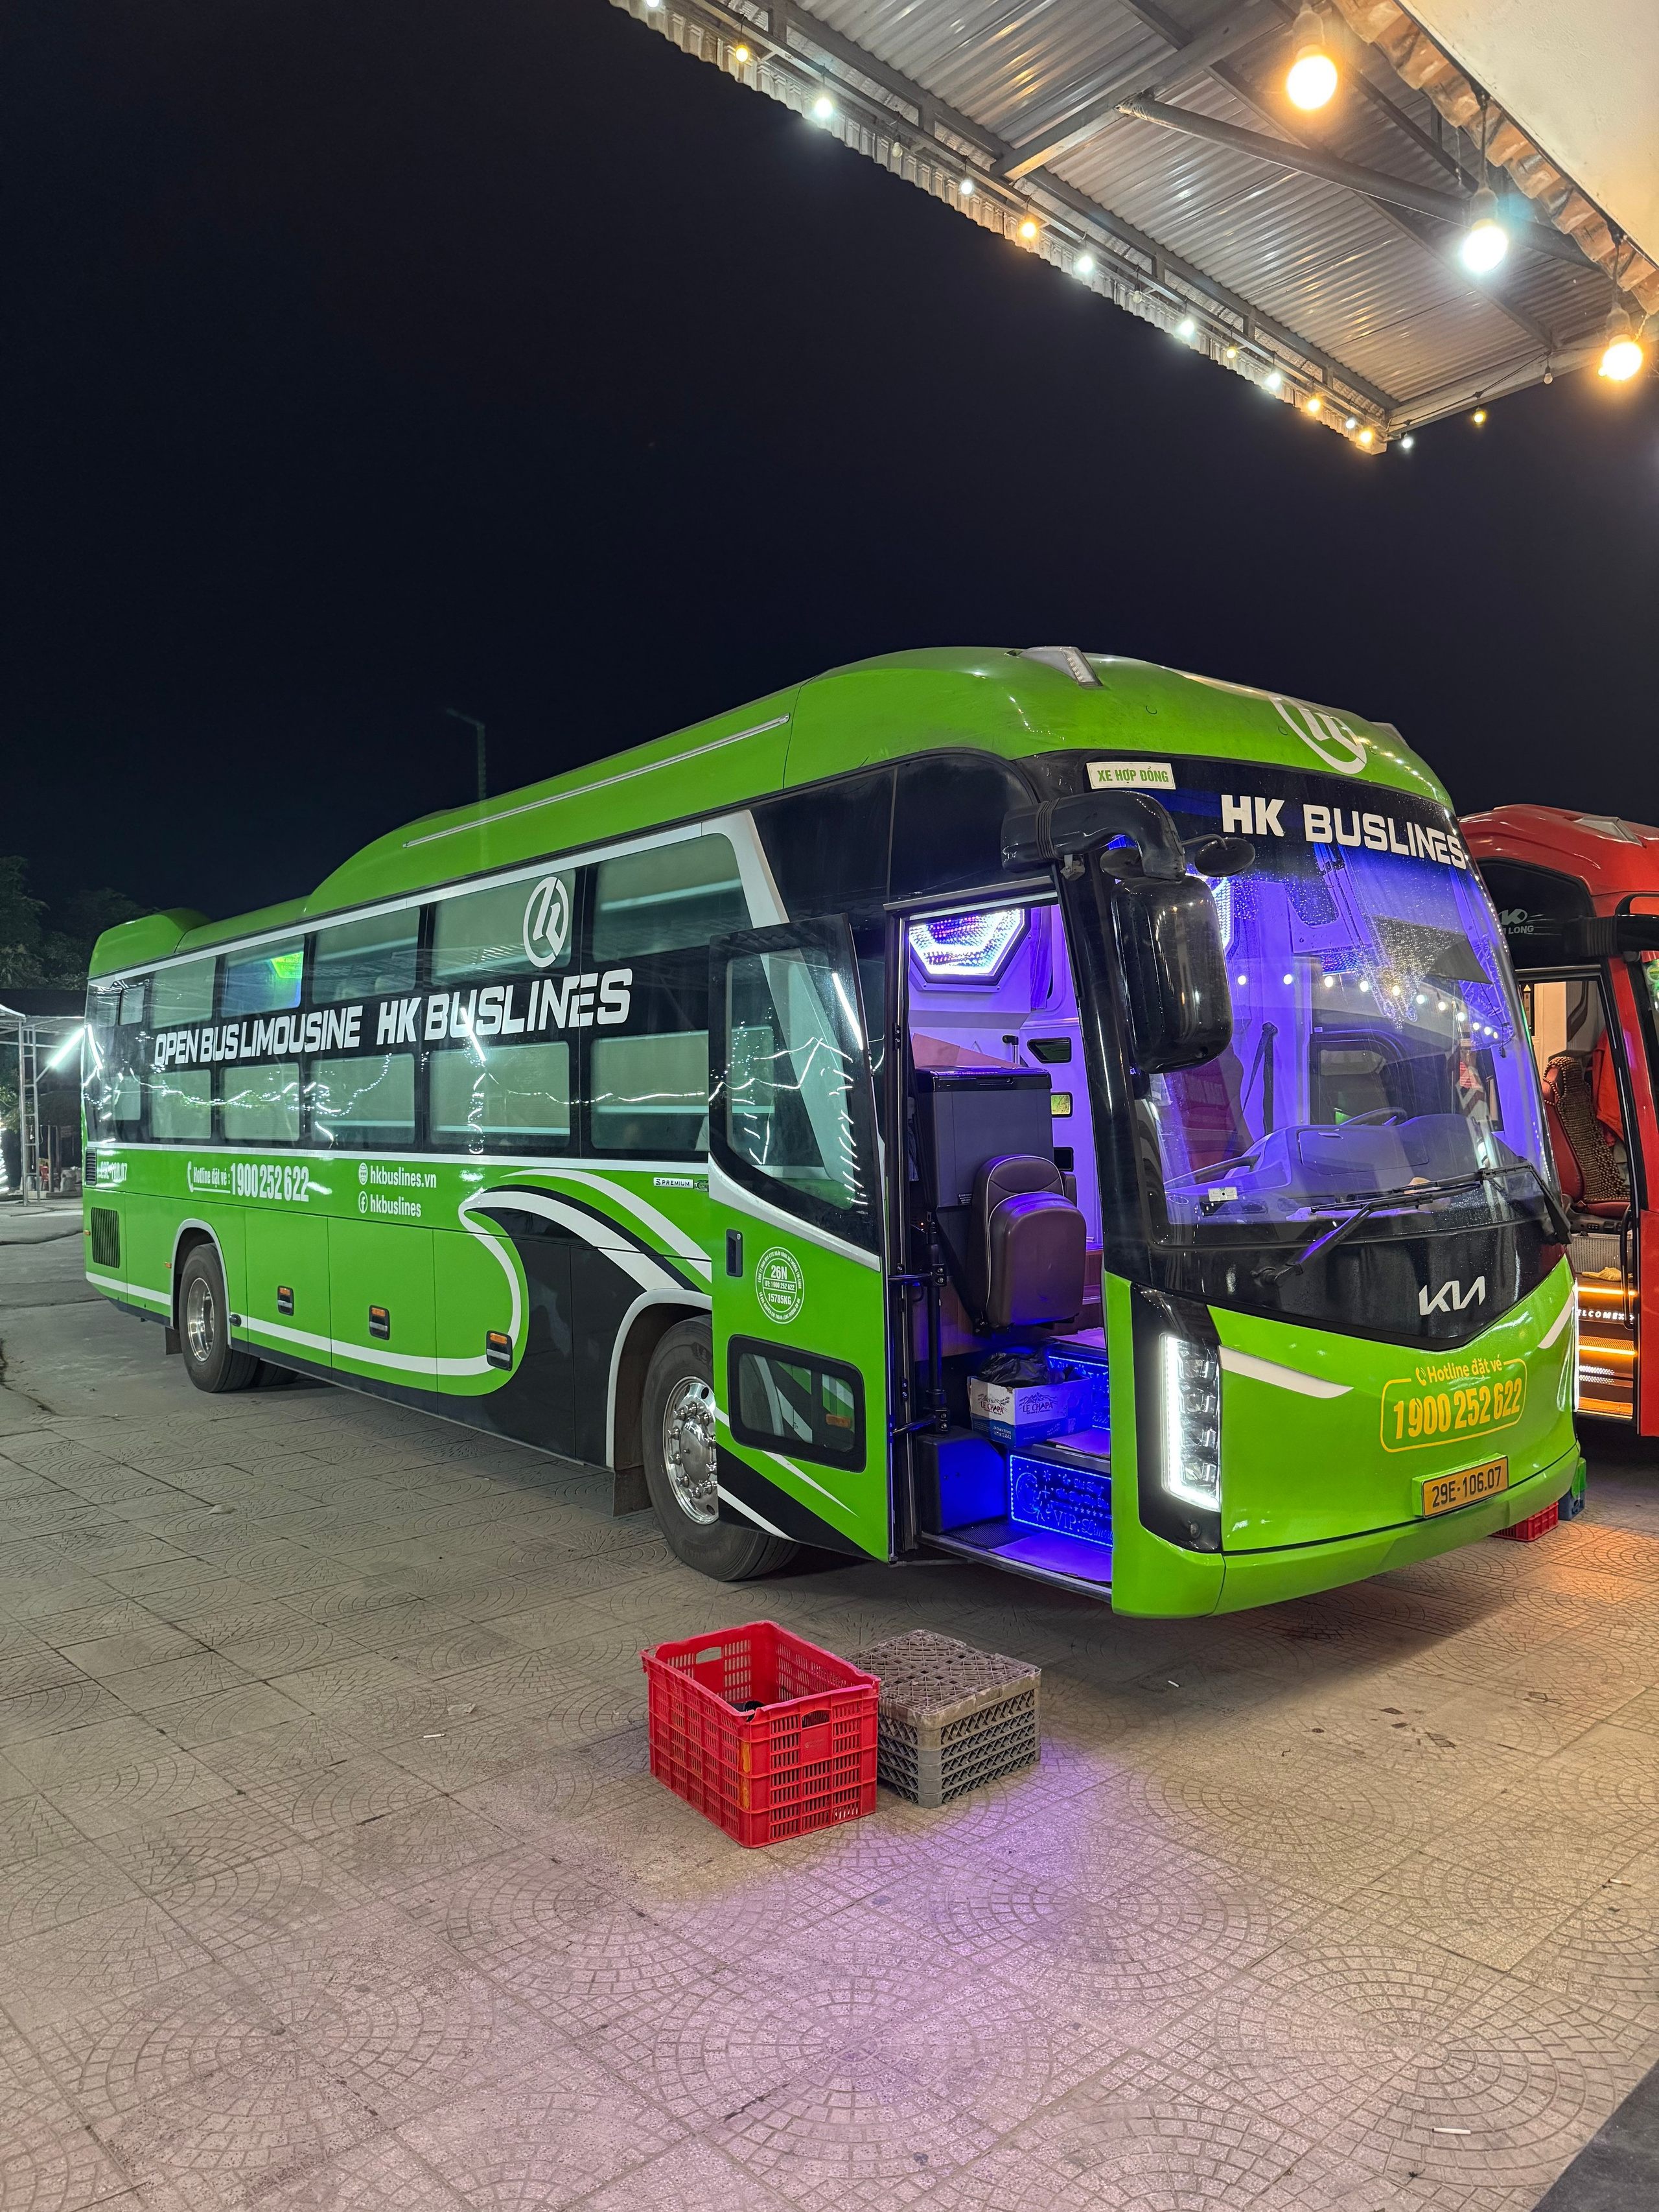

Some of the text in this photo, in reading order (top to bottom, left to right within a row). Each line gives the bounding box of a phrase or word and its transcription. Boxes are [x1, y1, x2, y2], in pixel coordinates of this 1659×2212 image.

[1097, 766, 1169, 784] XE HỢP ĐỒNG
[1221, 794, 1467, 870] HK BUSLINES
[1508, 925, 1534, 935] LONG
[154, 968, 632, 1065] OPEN BUS LIMOUSINE HK BUSLINES
[193, 1167, 211, 1185] Hotline
[211, 1167, 220, 1188] đặt
[231, 1163, 258, 1198] 1900
[259, 1164, 282, 1200] 252
[284, 1165, 309, 1202] 622
[370, 1165, 437, 1188] hkbuslines.vn
[370, 1194, 421, 1217] hkbuslines
[771, 1264, 787, 1280] 26N
[768, 1292, 791, 1305] 15785KG
[1577, 1309, 1618, 1320] ELCOME
[1427, 1354, 1502, 1383] Hotline đặt vé
[1394, 1378, 1522, 1439] 1900 252 622
[1432, 1466, 1501, 1508] 29E-106.07
